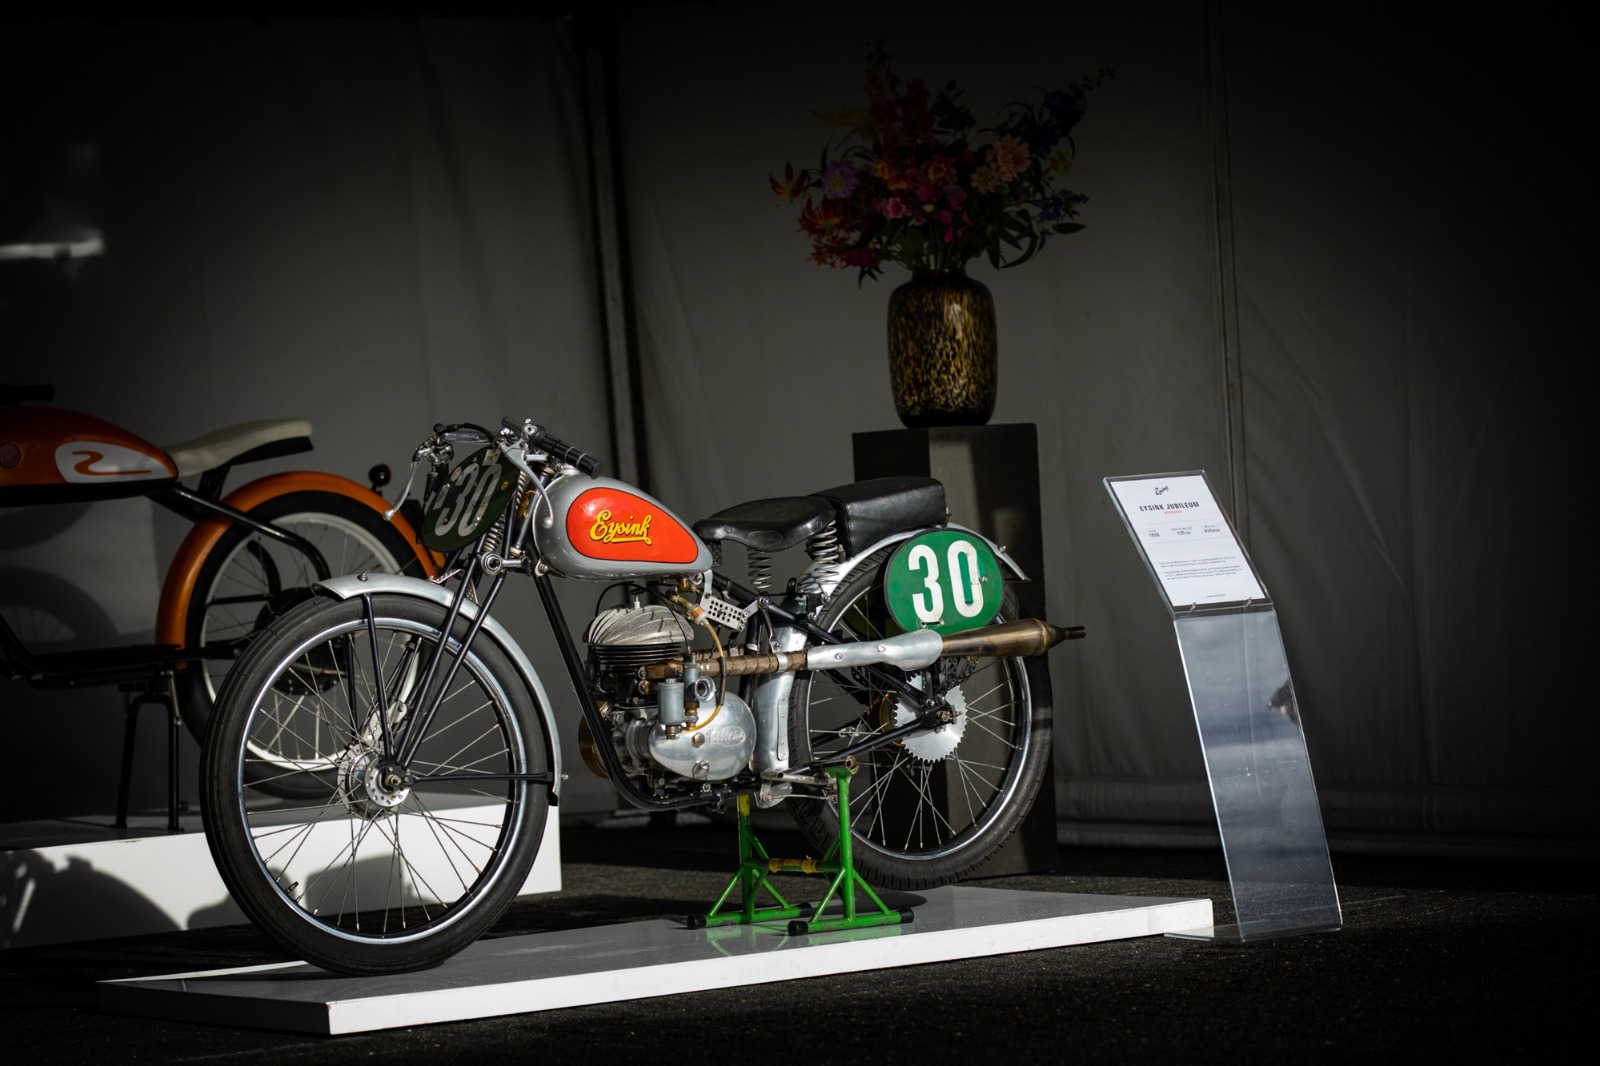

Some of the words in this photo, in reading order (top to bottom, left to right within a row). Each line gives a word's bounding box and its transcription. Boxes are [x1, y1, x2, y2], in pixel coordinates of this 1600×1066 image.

[435, 463, 502, 536] 30
[1139, 504, 1165, 512] EYSINK
[1166, 501, 1200, 510] JUBILEUM
[589, 509, 652, 545] Eysink
[908, 540, 984, 622] 30
